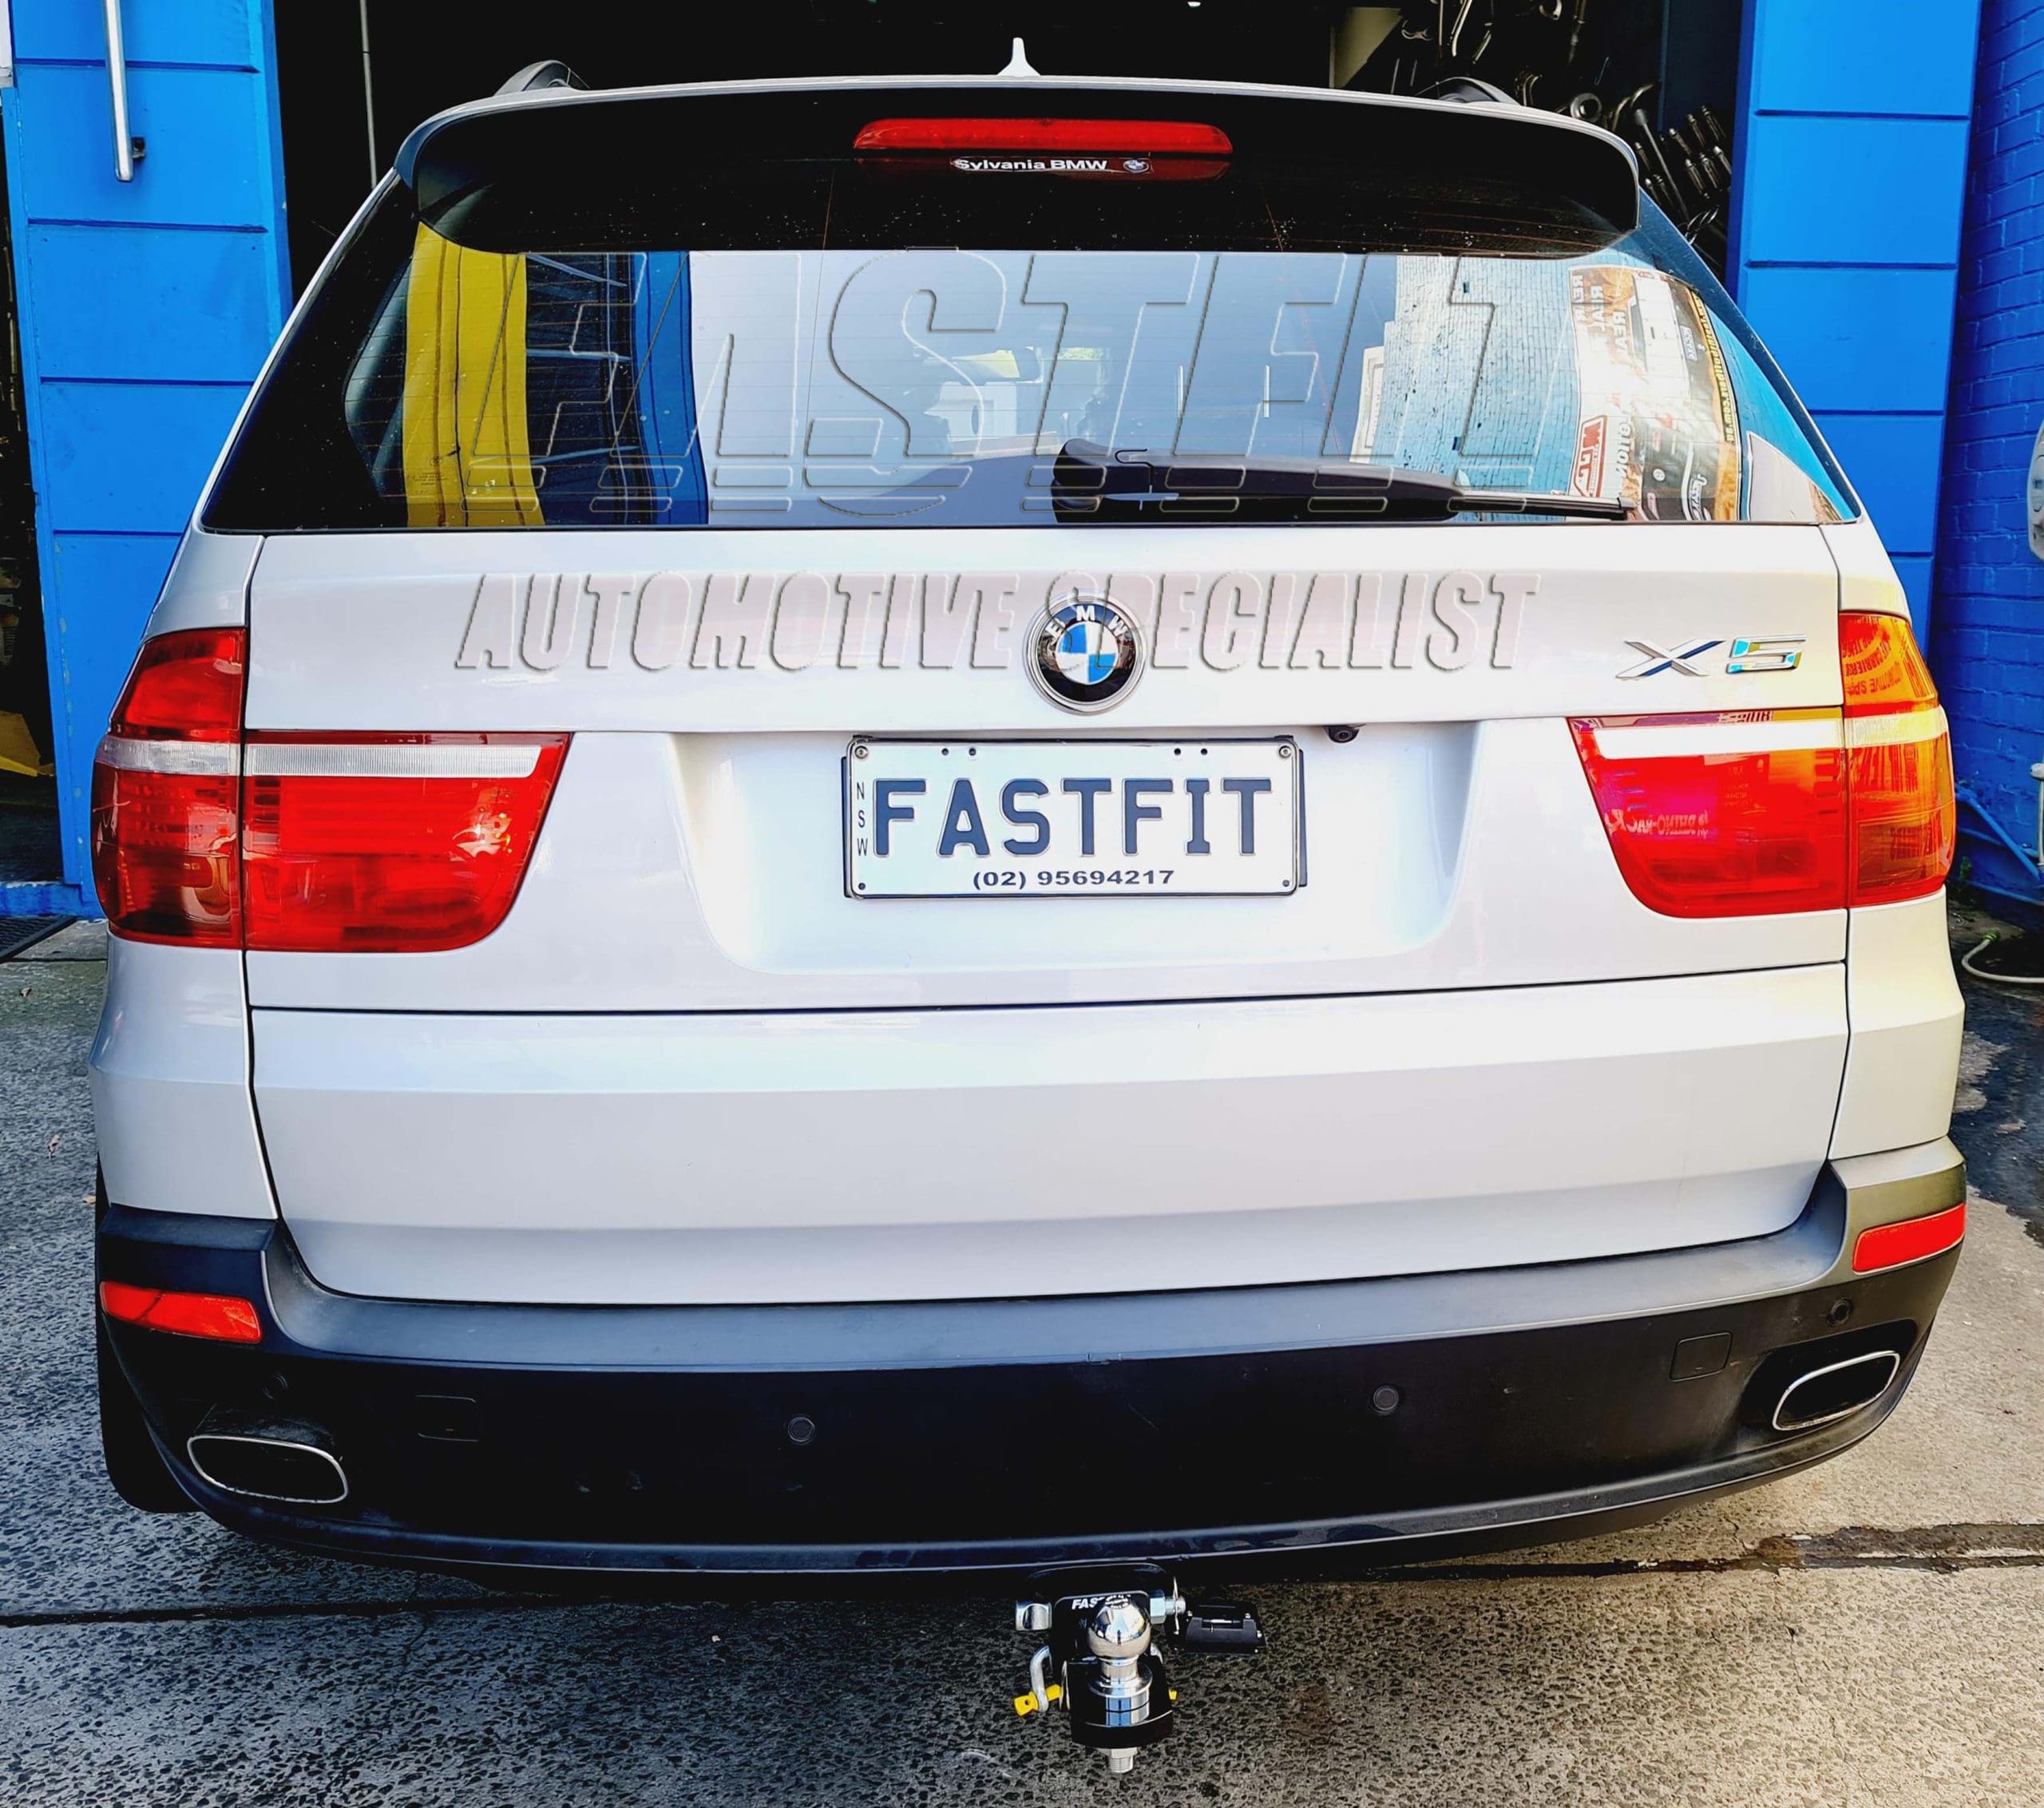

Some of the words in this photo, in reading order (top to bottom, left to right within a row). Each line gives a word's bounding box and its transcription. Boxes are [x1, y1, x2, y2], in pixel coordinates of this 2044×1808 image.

[955, 159, 1045, 171] Sylvania
[1050, 159, 1107, 170] BMW
[1614, 635, 1807, 678] X5
[873, 777, 1272, 857] FASTFIT
[972, 871, 1027, 890] (02)
[1037, 870, 1175, 887] 95694217
